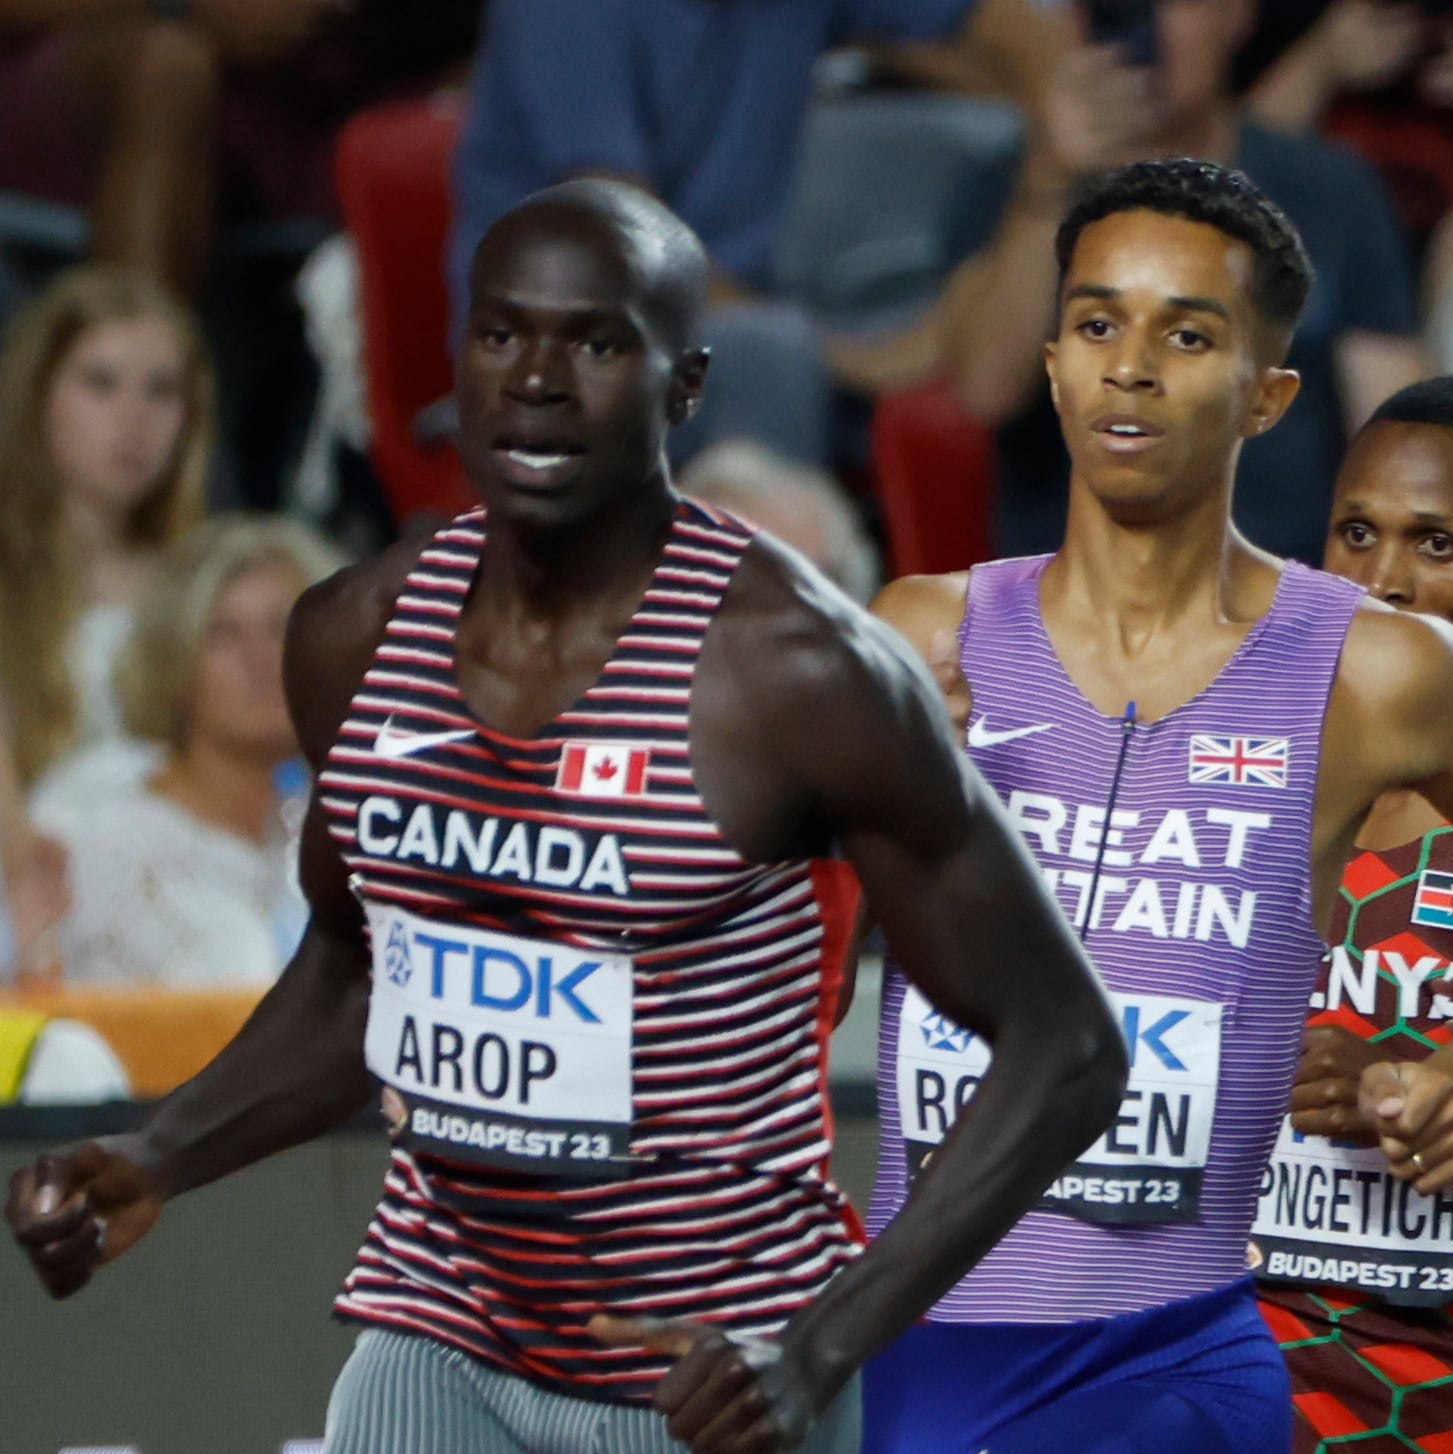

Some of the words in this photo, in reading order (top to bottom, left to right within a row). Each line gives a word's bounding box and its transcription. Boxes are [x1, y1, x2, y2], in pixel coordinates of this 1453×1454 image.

[355, 796, 630, 895] CANADA
[1006, 790, 1272, 868] REAT
[1042, 868, 1257, 949] TAIN
[414, 933, 605, 1024] TDK
[395, 1017, 557, 1105] AROP
[412, 1108, 565, 1160] BUDAPEST
[570, 1133, 611, 1160] 23
[1043, 1177, 1141, 1204] APEST
[1144, 1181, 1180, 1203] 23
[1268, 1252, 1417, 1289] BUDAPEST
